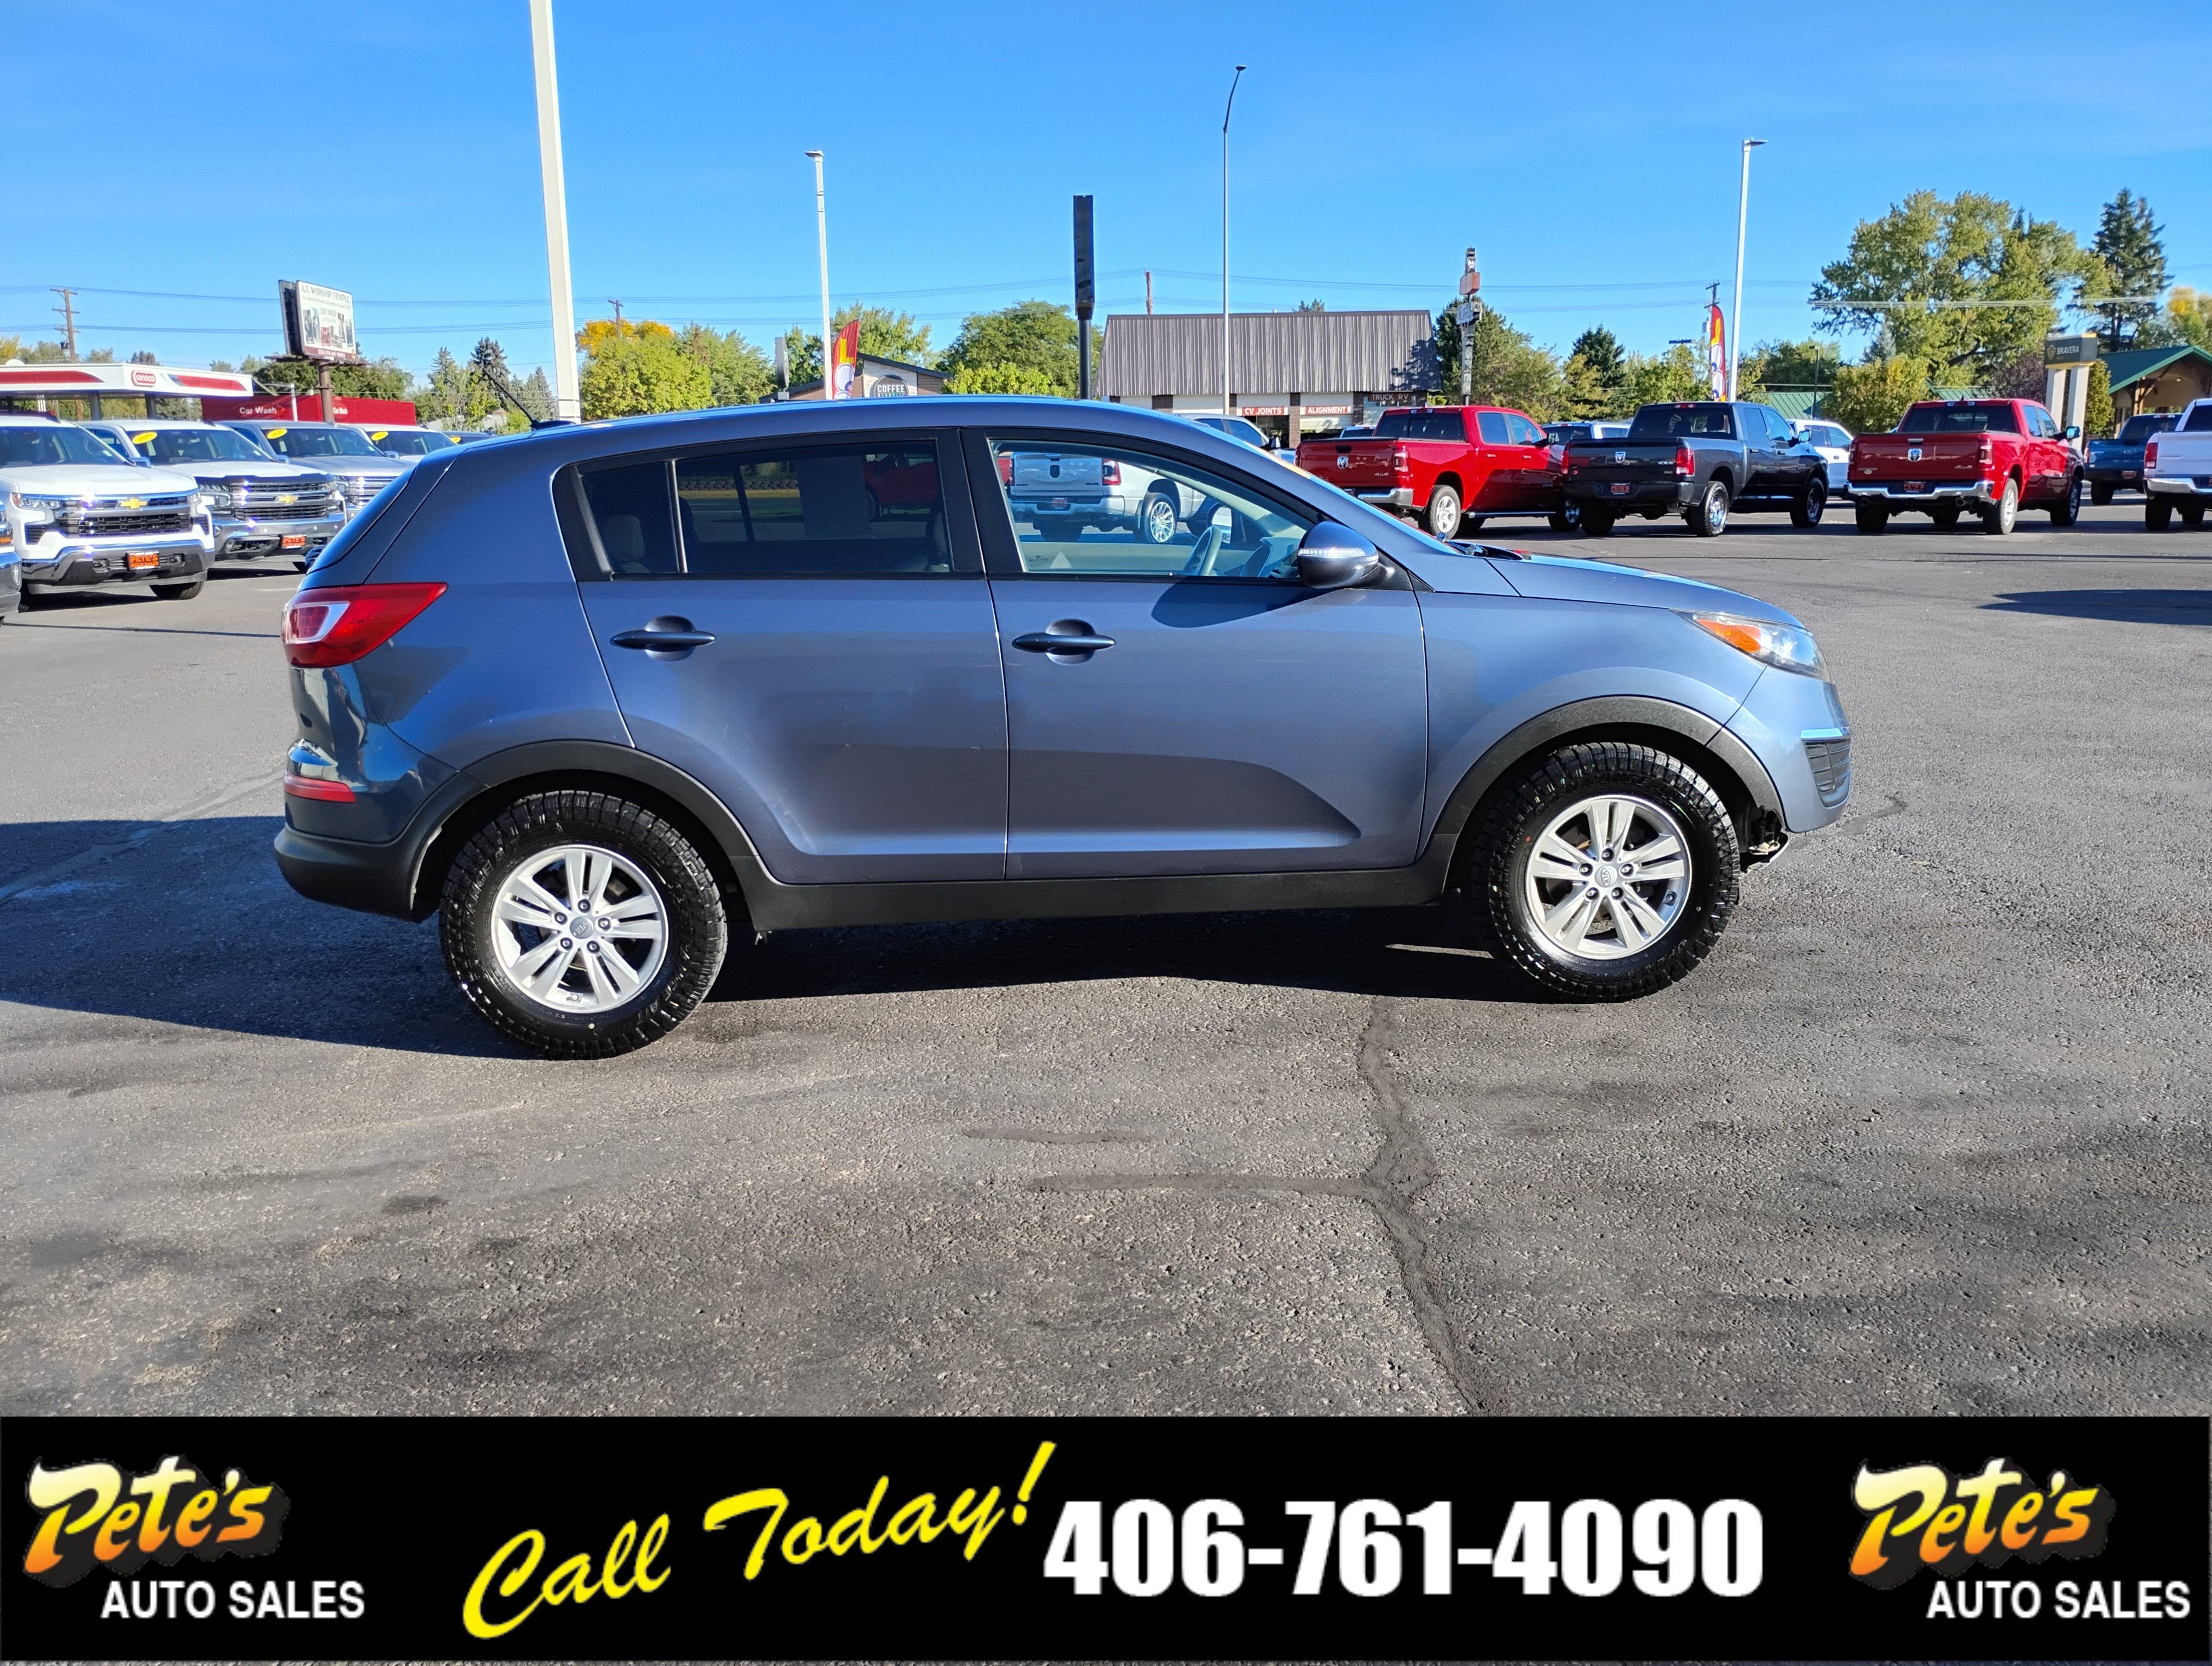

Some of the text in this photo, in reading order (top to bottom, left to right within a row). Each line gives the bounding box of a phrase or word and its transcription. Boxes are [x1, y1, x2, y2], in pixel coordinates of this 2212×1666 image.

[310, 287, 332, 298] WORSHIP
[333, 292, 350, 303] TEMPLE
[2057, 346, 2080, 355] BRAVERA
[877, 385, 905, 393] COFFEE
[1307, 406, 1347, 414] ALIGNMENT
[130, 554, 158, 562] PETE'S
[1602, 869, 1611, 885] KIA
[575, 922, 588, 934] KIA
